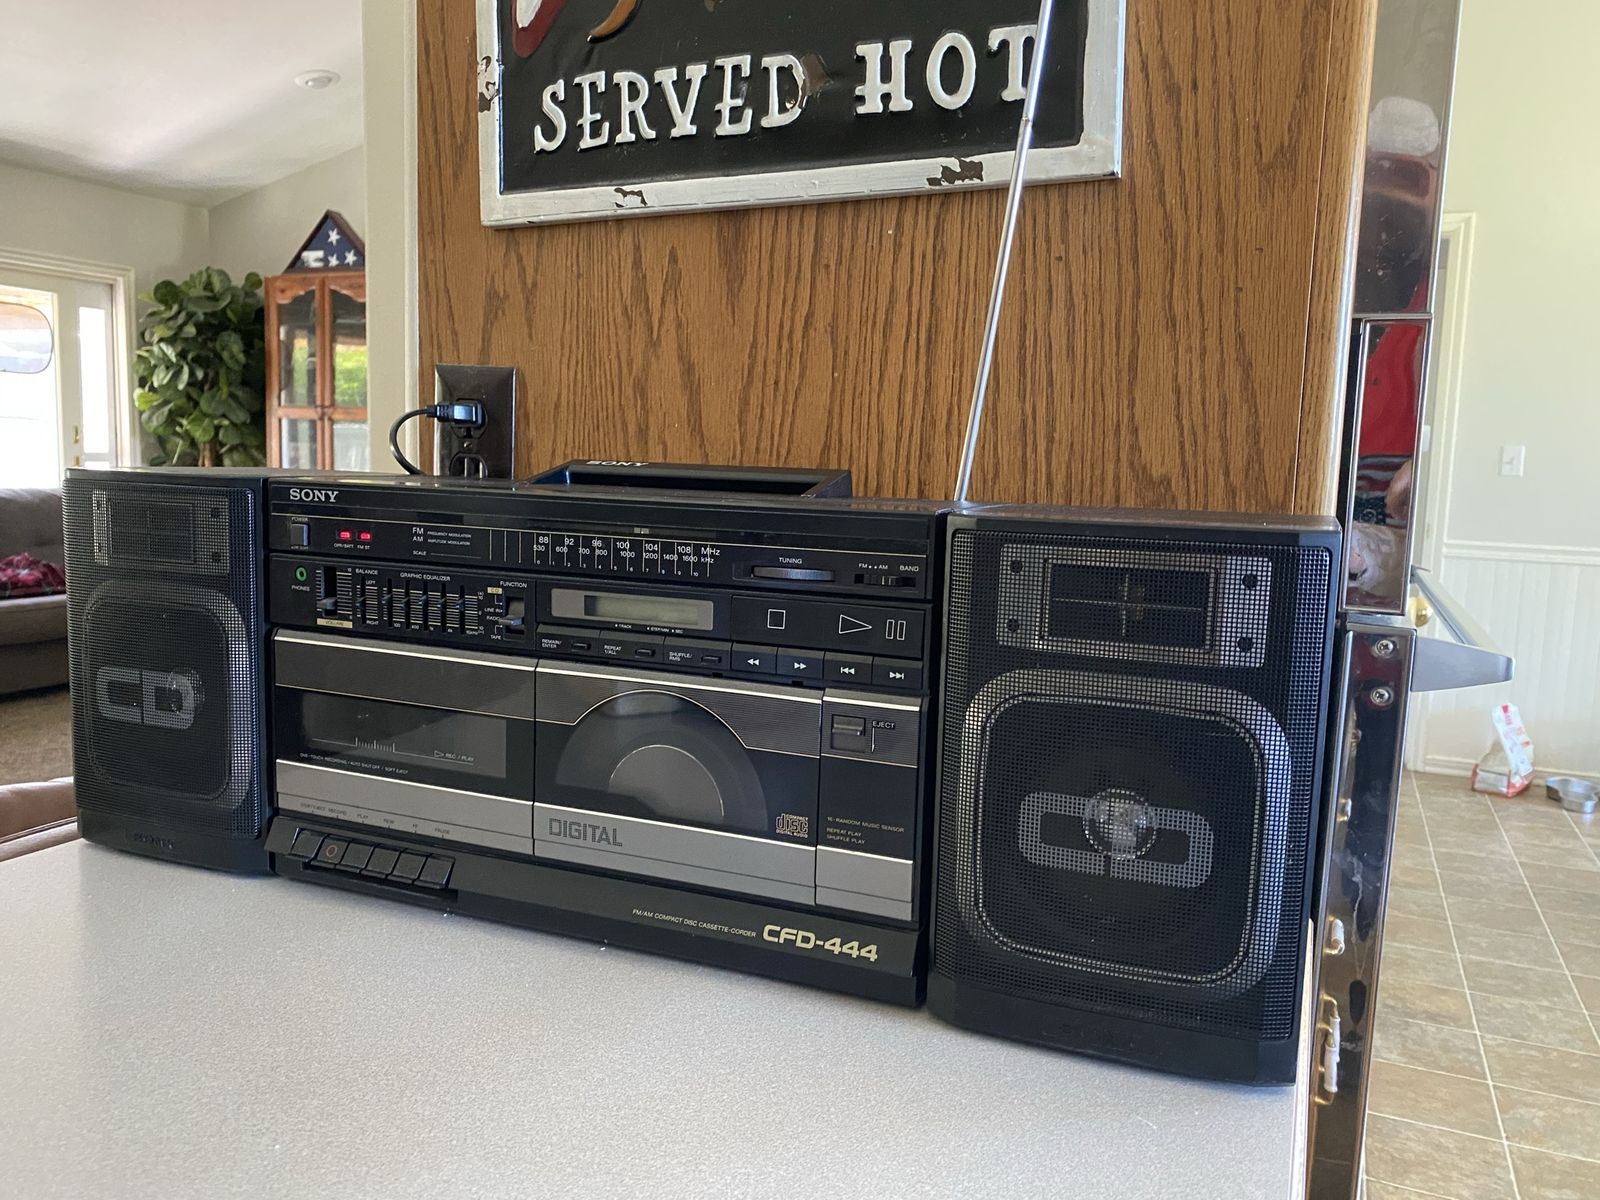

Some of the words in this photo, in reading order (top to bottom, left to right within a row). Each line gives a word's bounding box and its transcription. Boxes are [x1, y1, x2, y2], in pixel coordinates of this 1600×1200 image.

[533, 54, 807, 154] SERVED
[855, 24, 1041, 115] HOT
[289, 488, 339, 502] SONY
[412, 527, 424, 535] FM
[538, 536, 549, 544] 88
[564, 537, 575, 546] 92
[591, 540, 602, 548] 96
[616, 541, 630, 549] 100
[644, 543, 658, 551] 104
[677, 545, 691, 554] 108
[701, 547, 720, 556] MHz
[578, 547, 590, 555] 700
[620, 550, 635, 558] 1000
[643, 552, 658, 560] 1200
[682, 555, 698, 563] 1600
[700, 556, 715, 564] kHz
[778, 557, 803, 565] TUNING
[355, 568, 379, 576] BALANCE
[899, 565, 920, 573] BAND
[400, 572, 422, 580] GRAPHIC
[423, 574, 451, 582] EQUALIZER
[500, 581, 528, 589] FUNCTION
[872, 720, 895, 729] EJECT
[549, 818, 623, 847] DIGITAL
[861, 821, 880, 829] MUSIC
[880, 824, 905, 833] SENSOR
[850, 837, 865, 845] PLAY
[632, 908, 654, 918] FM/AM
[654, 912, 683, 924] COMPACT
[683, 918, 698, 927] DISC
[698, 921, 757, 938] CASSETTE-CORDER
[762, 924, 878, 962] CFD-444
